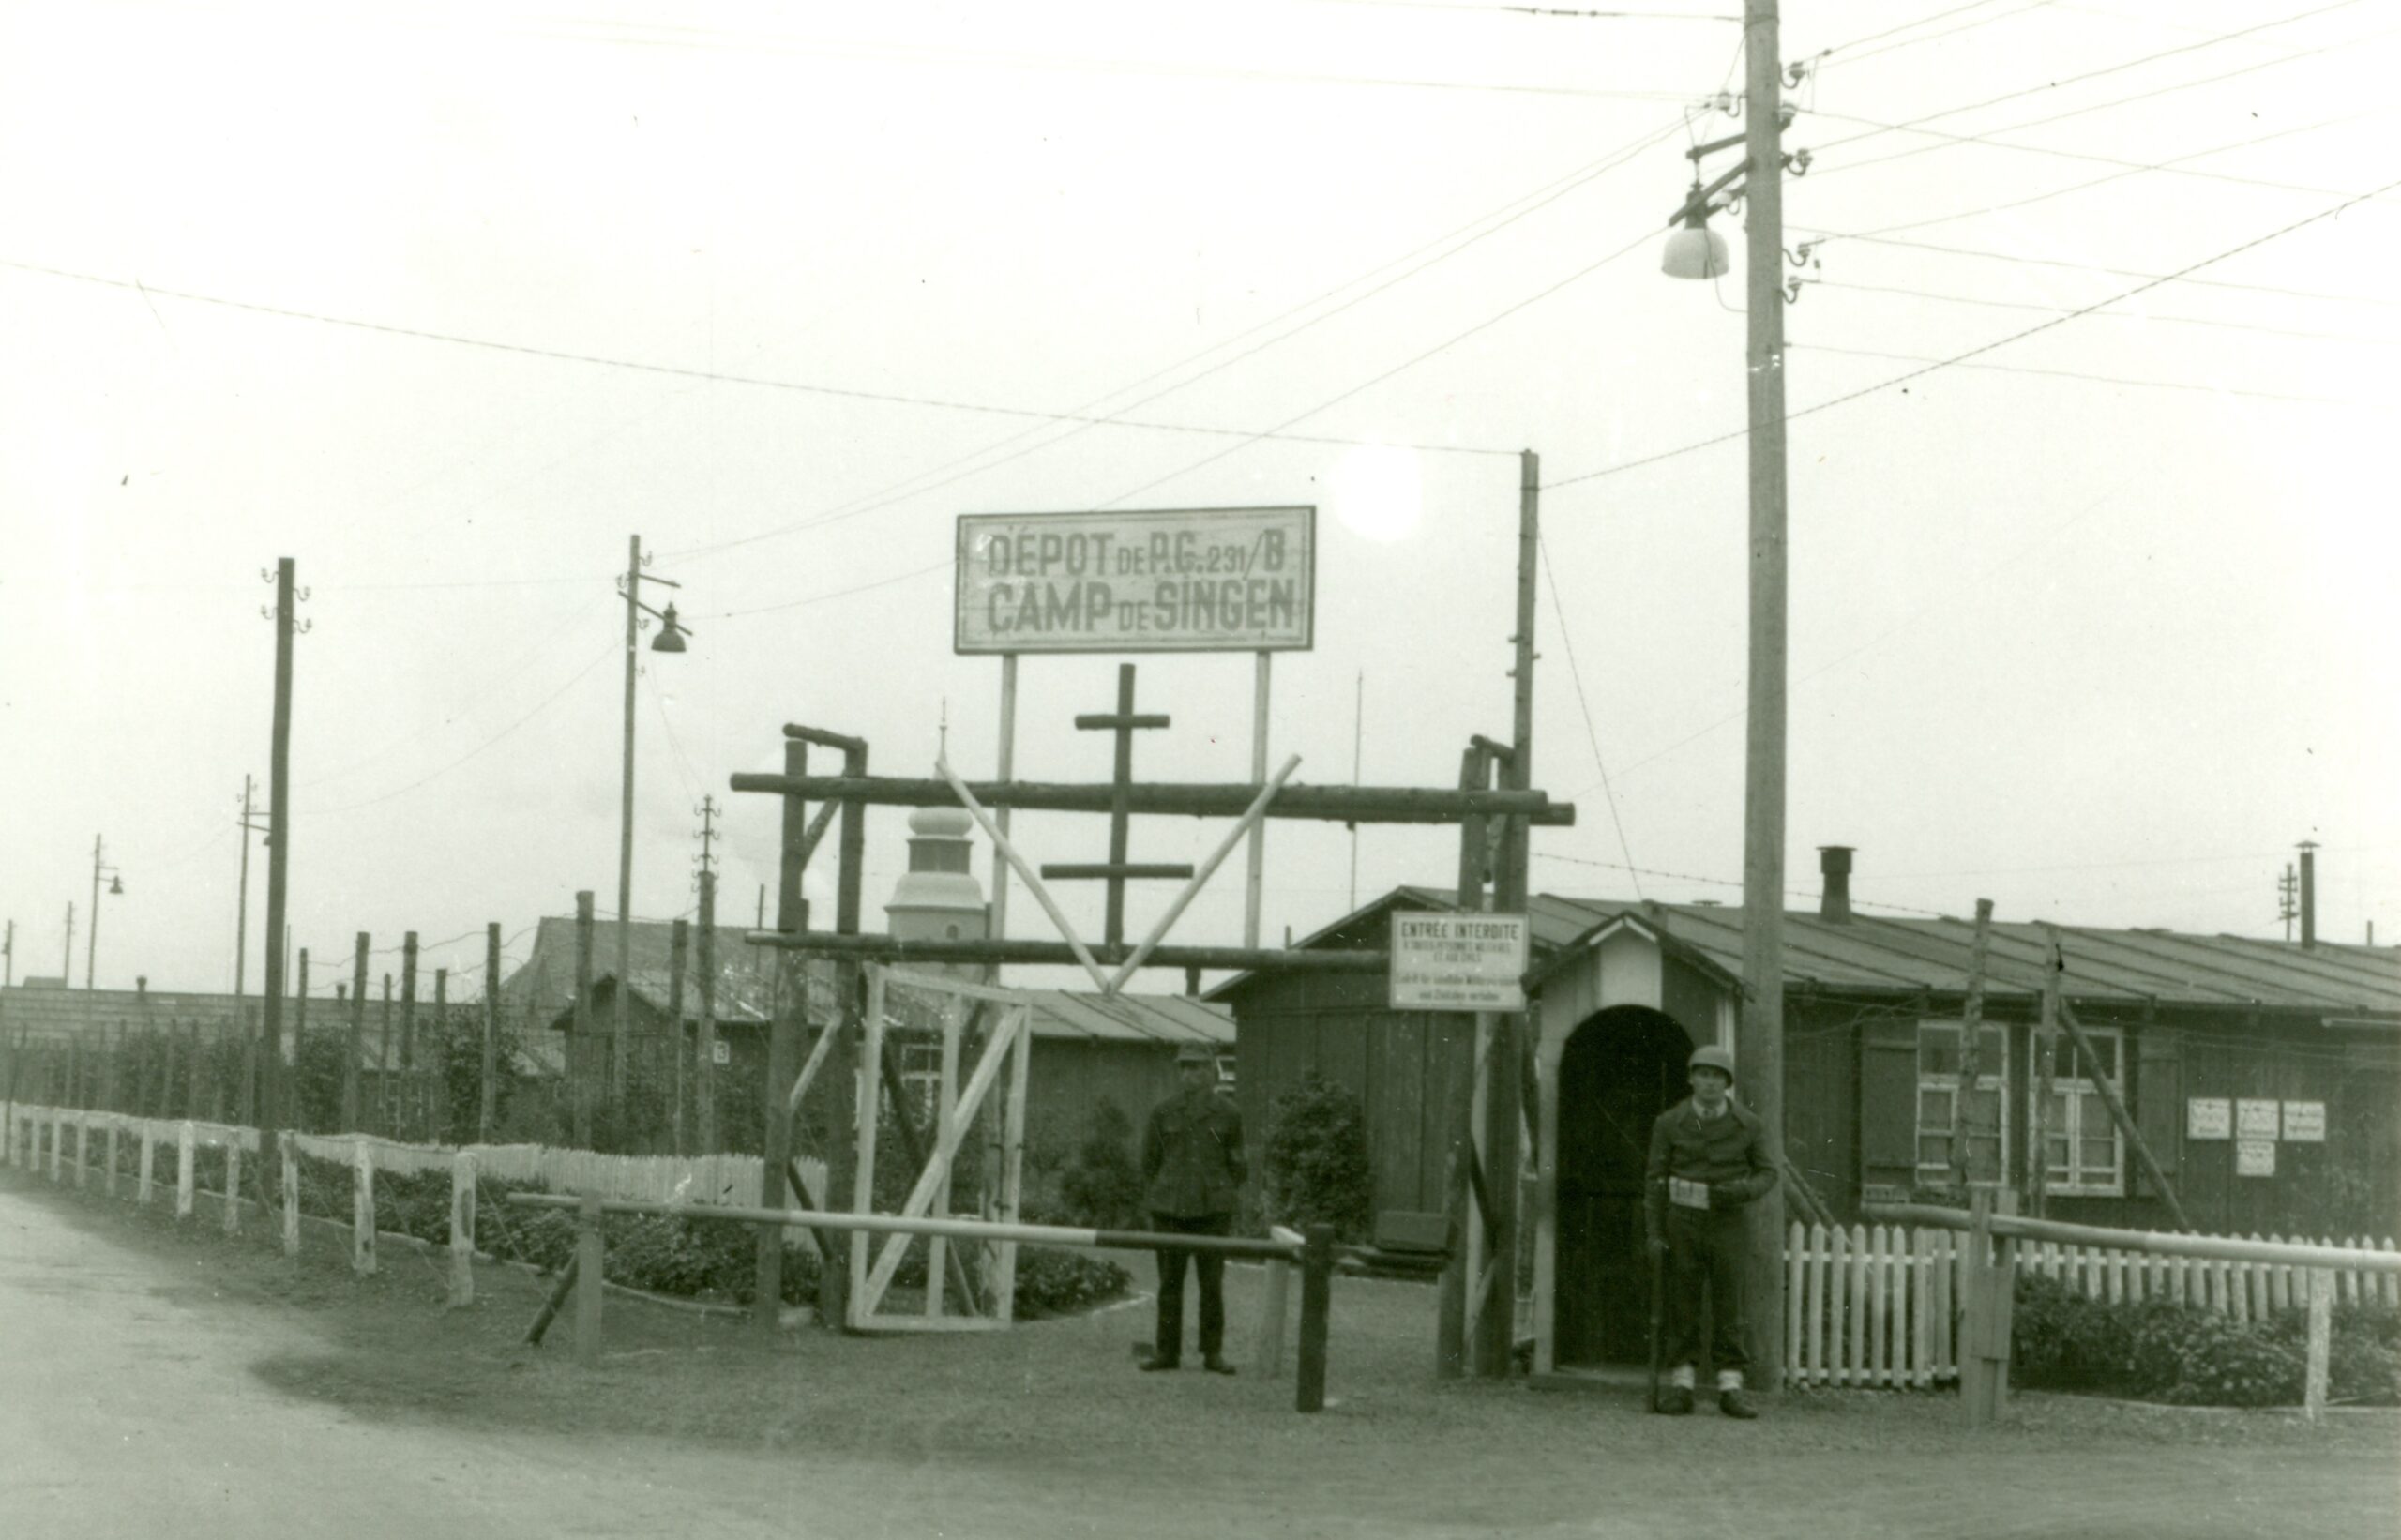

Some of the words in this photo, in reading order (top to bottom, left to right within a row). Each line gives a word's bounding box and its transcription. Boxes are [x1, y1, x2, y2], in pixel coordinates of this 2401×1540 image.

[1117, 546, 1145, 576] DE
[988, 581, 1113, 633] CAMP
[1118, 600, 1148, 632] DE
[1154, 578, 1295, 632] SINGEN
[1454, 923, 1519, 940] INTERDITE
